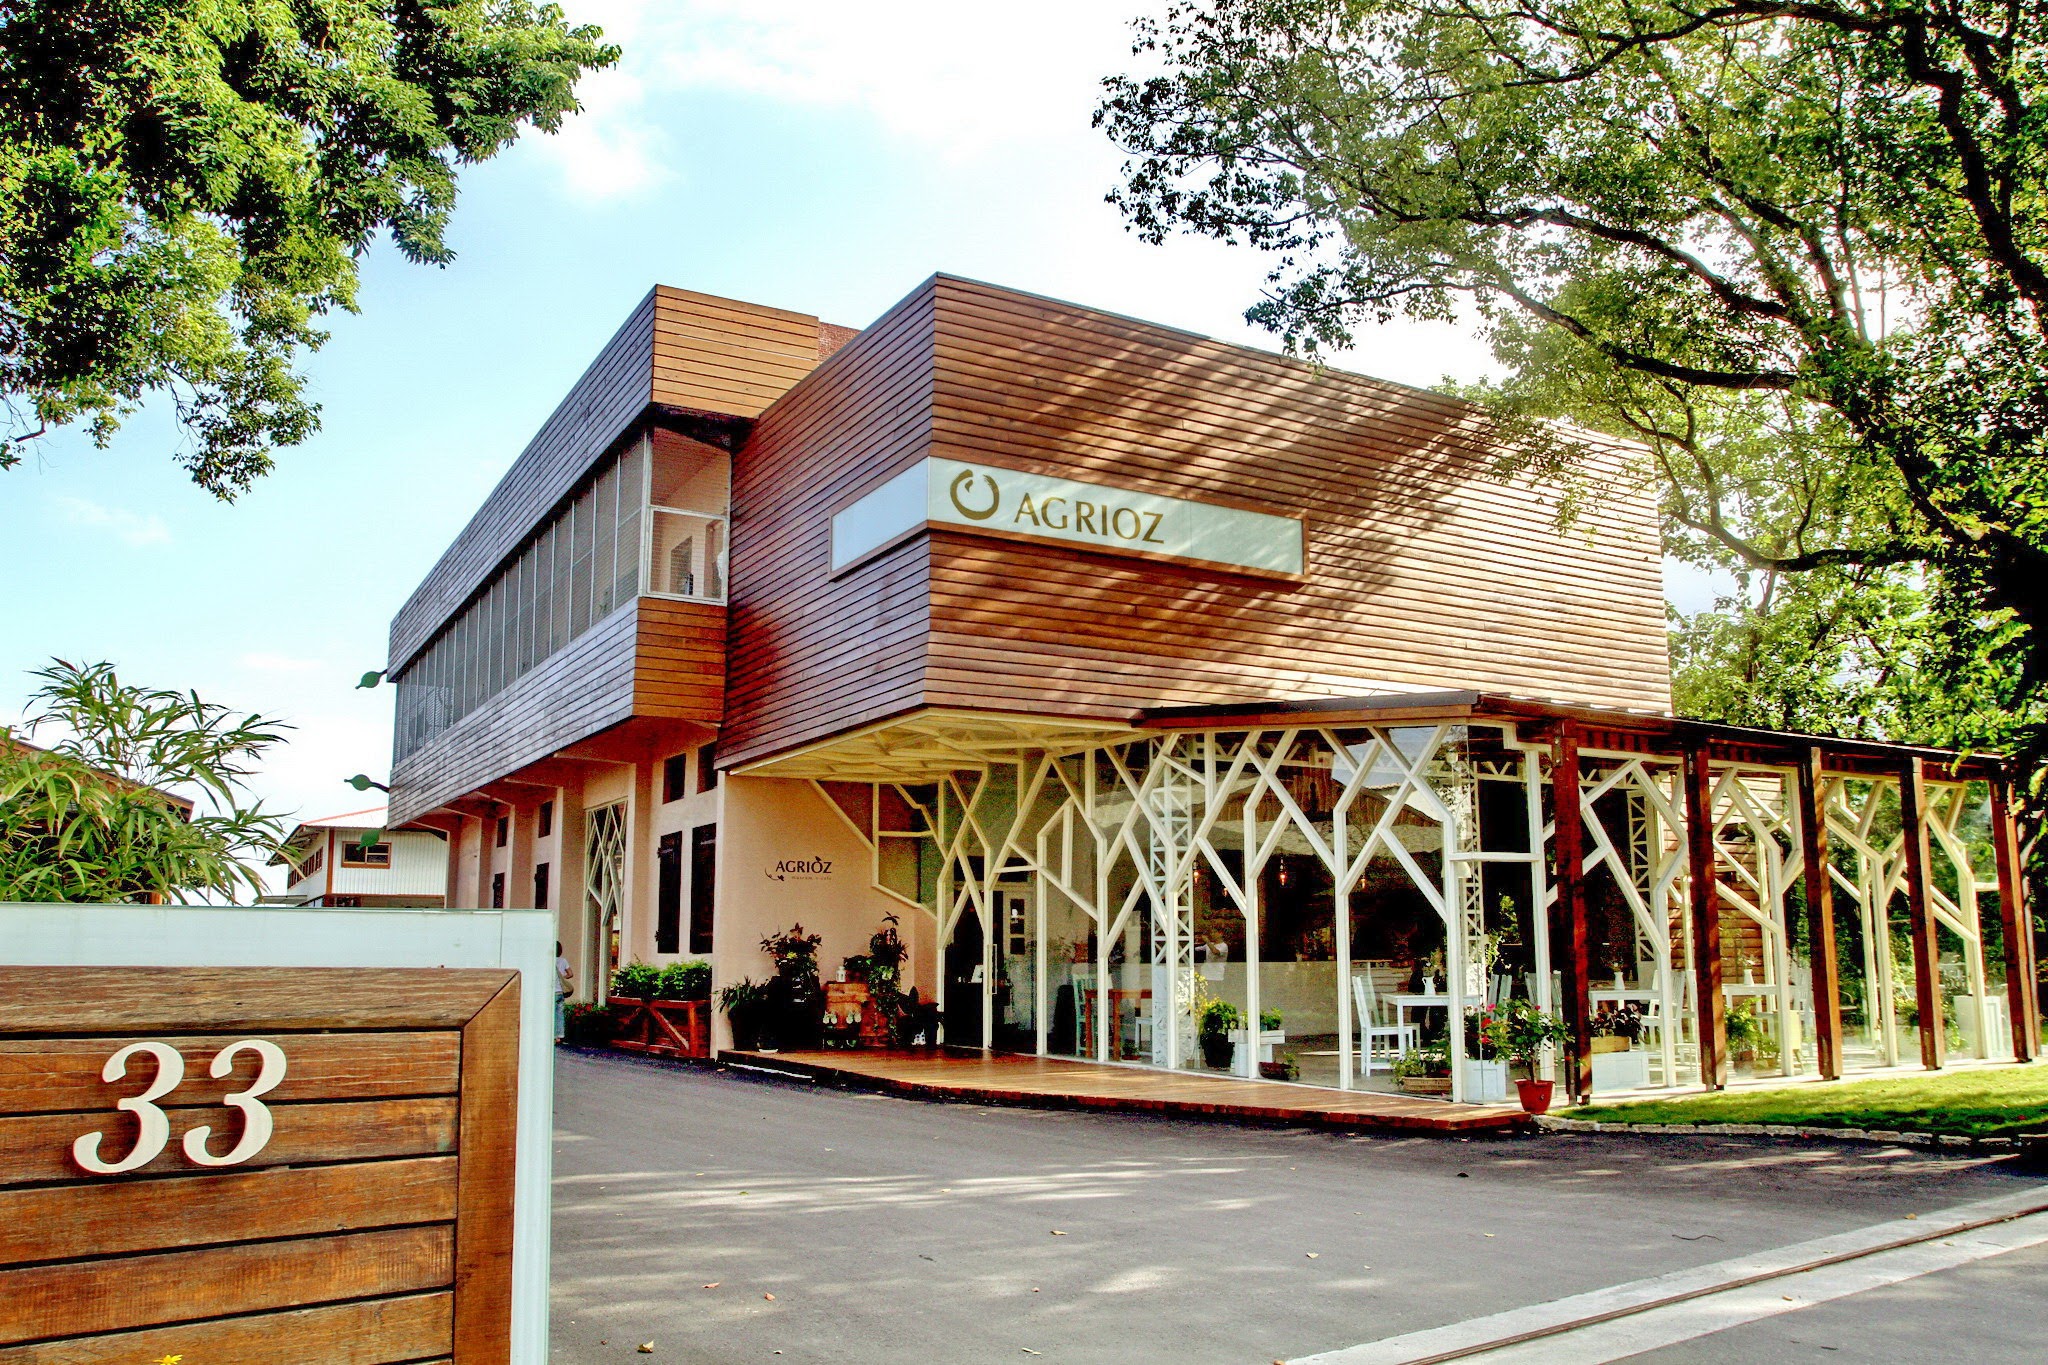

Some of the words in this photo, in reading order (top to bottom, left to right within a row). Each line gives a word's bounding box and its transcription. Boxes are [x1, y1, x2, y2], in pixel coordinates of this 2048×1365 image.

[1014, 492, 1165, 544] AGRIOZ
[775, 860, 832, 874] AGRIOZ
[73, 1039, 288, 1174] 33
